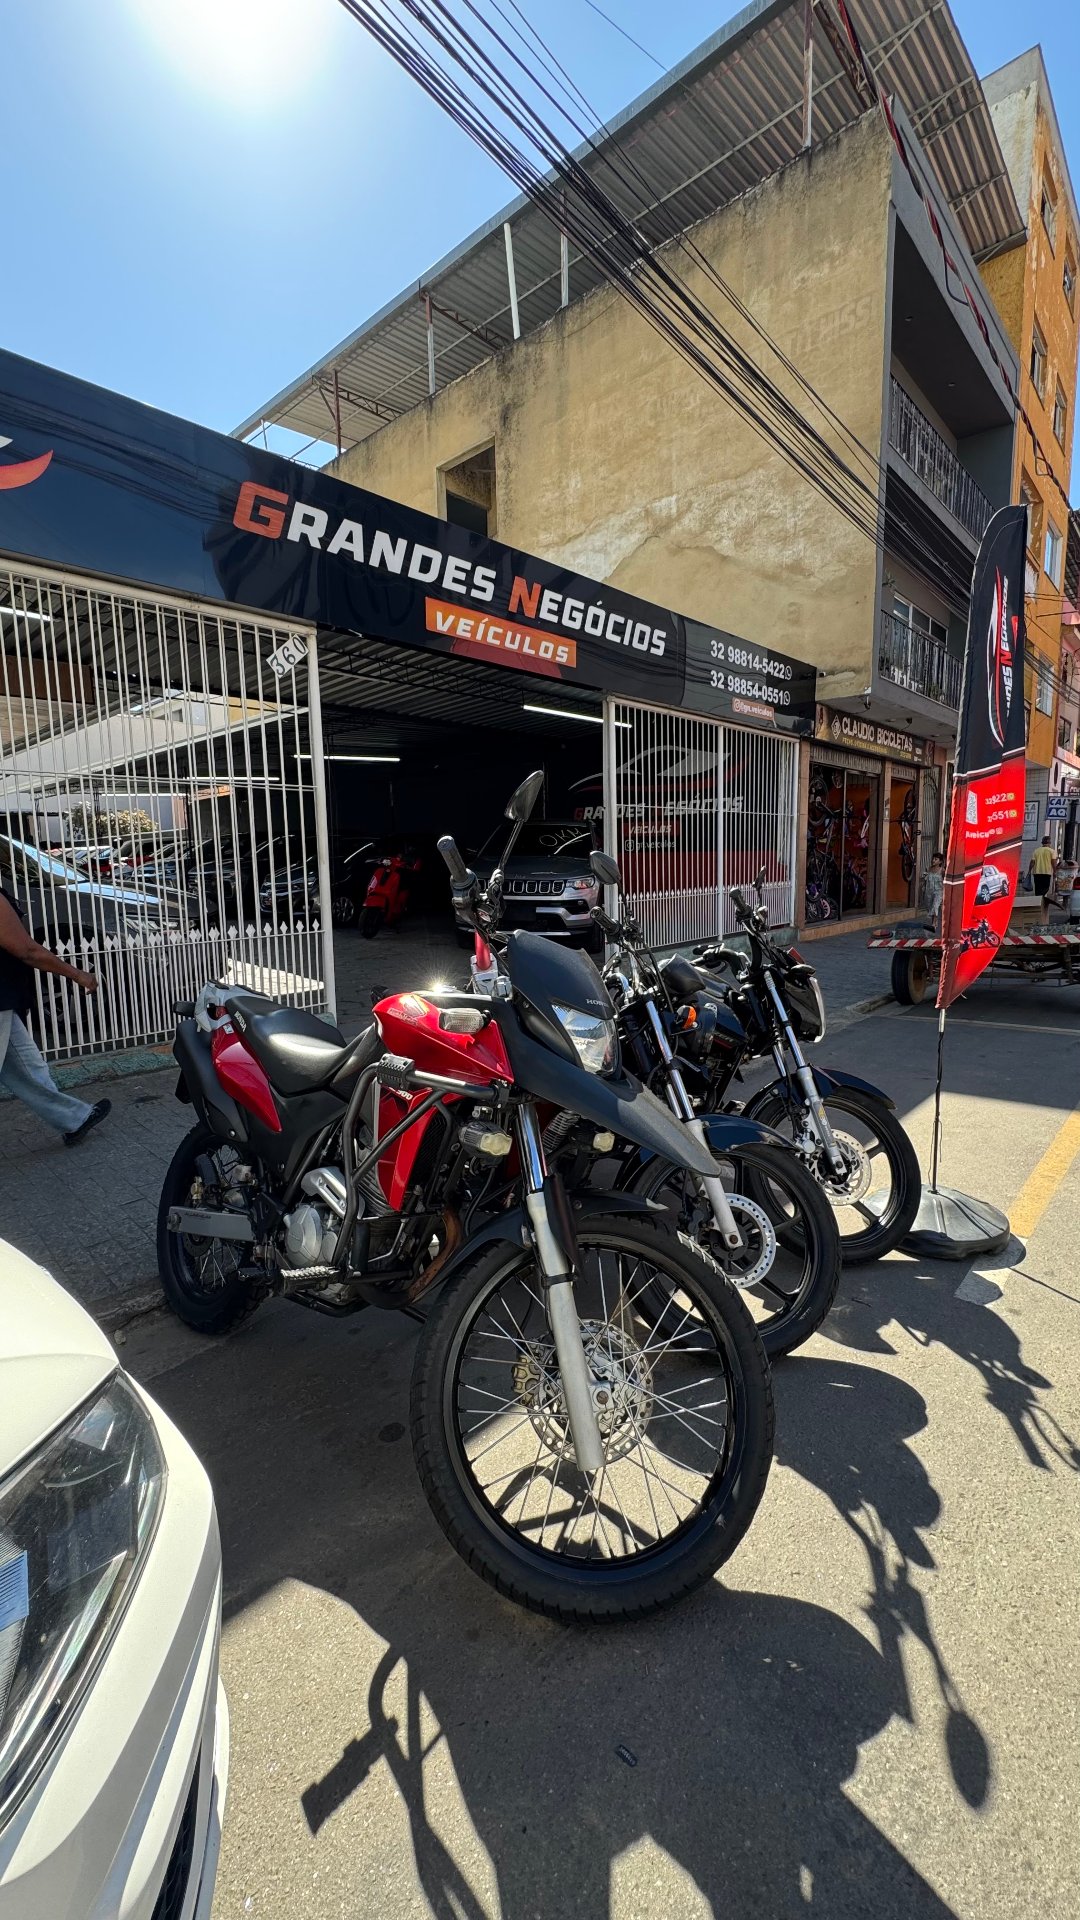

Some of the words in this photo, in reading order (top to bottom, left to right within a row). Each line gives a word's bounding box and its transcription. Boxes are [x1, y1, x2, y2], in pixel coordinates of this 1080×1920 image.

[232, 481, 496, 602] GRANDES
[508, 575, 667, 656] NEGÓCIOS
[434, 611, 569, 664] VEÍCULOS
[270, 637, 306, 676] 360
[710, 640, 725, 660] 32
[727, 646, 785, 680] 98814-5422
[710, 670, 725, 690] 32
[727, 676, 784, 706] 98854-0551
[876, 727, 913, 752] BICICLETAS
[574, 802, 646, 820] GRADES
[233, 1010, 247, 1033] HONDA
